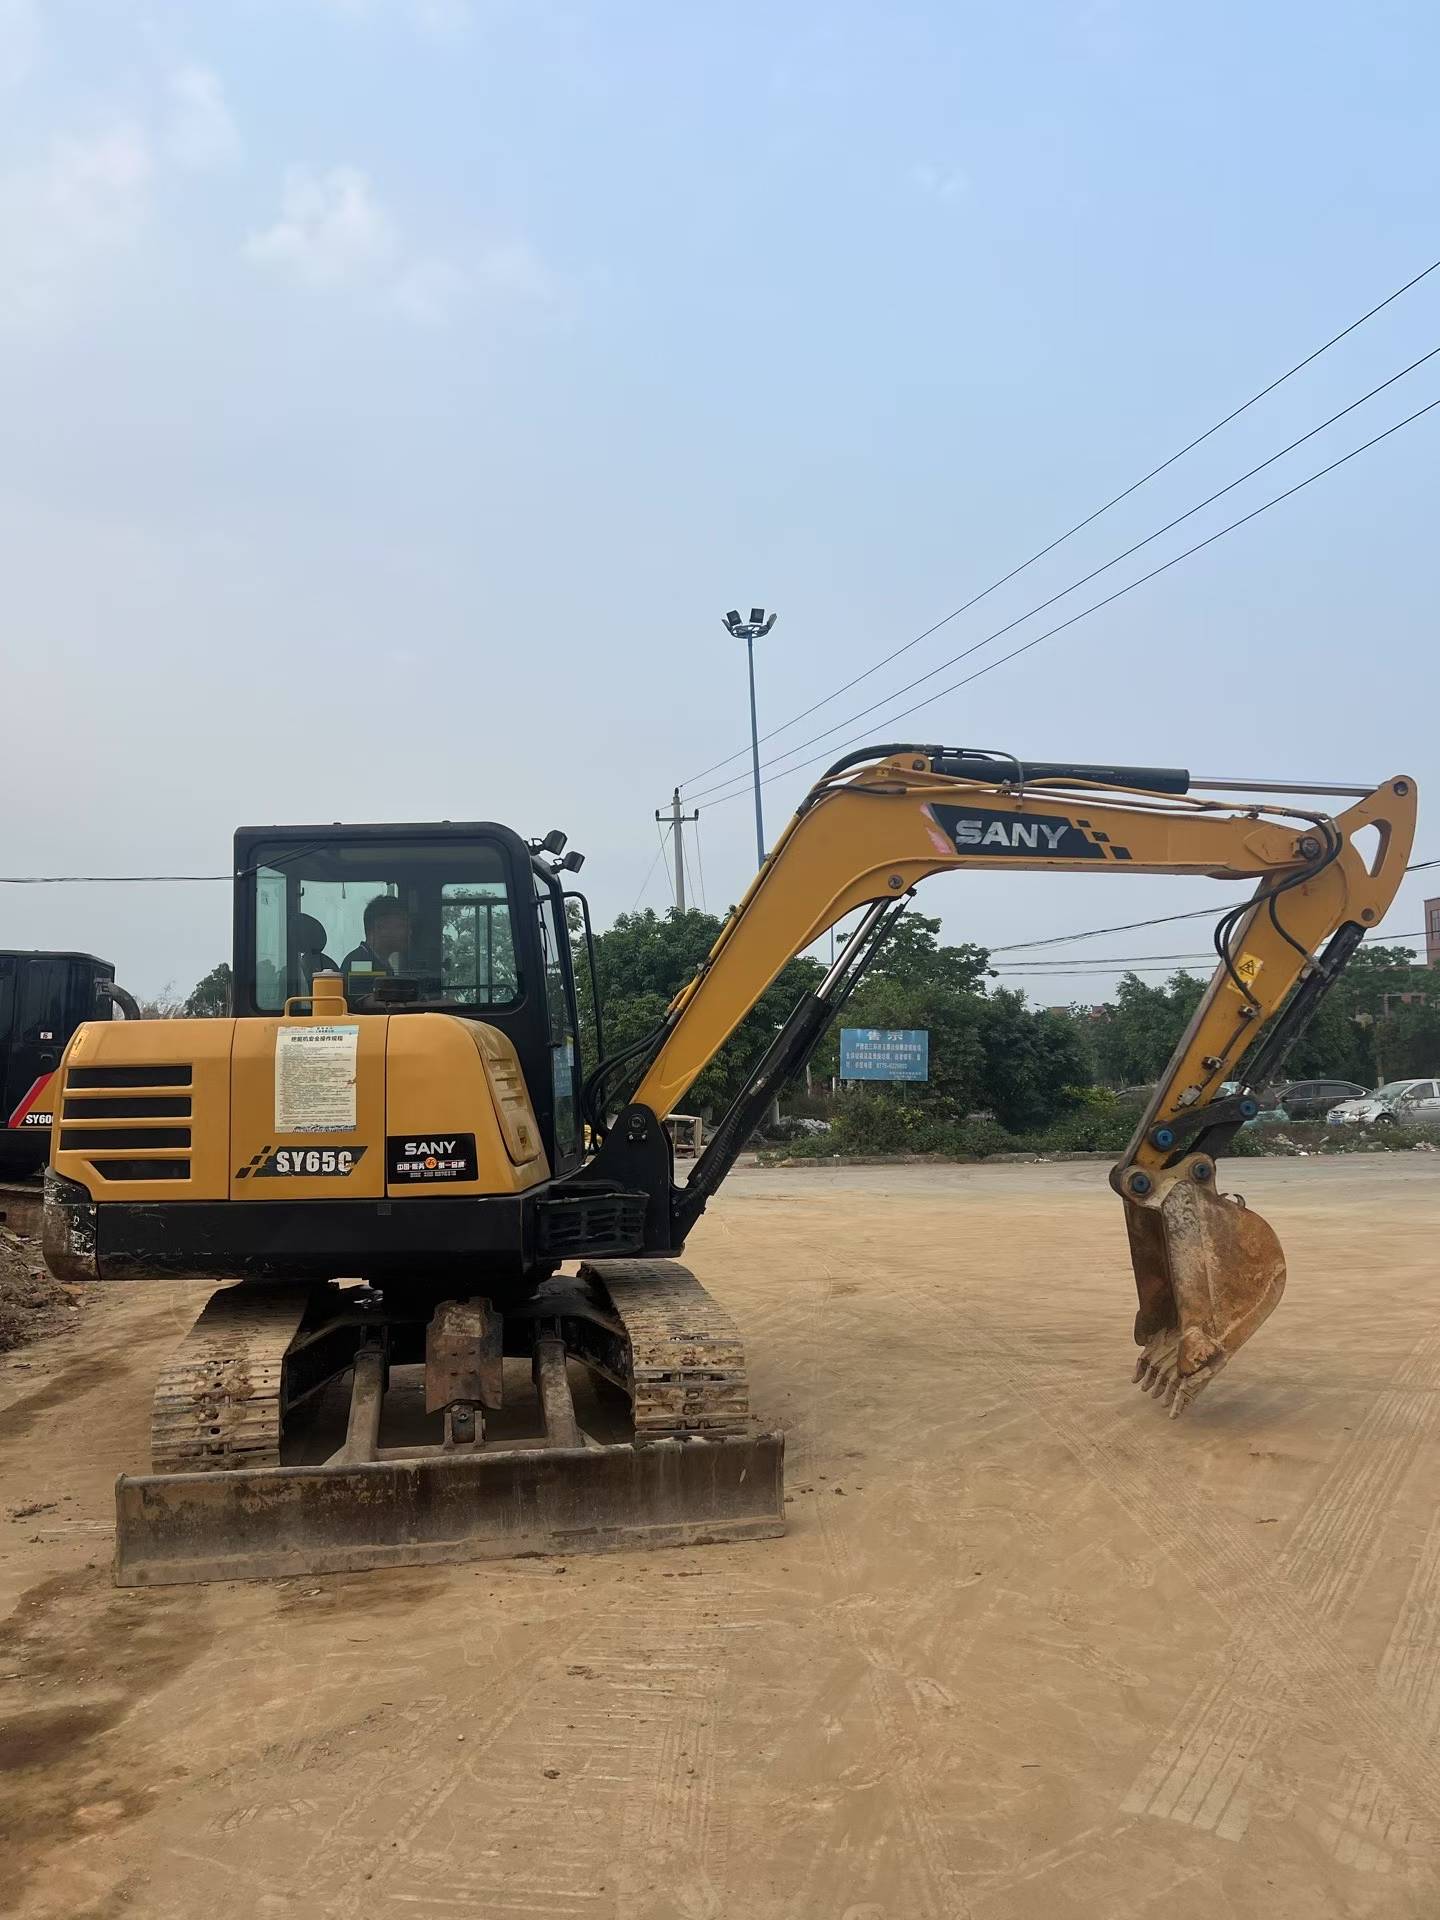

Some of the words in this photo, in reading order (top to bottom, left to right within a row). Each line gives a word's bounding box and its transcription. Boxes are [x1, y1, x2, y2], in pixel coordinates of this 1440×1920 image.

[955, 819, 1069, 849] SANY
[25, 1114, 53, 1124] SY60
[404, 1141, 456, 1155] SANY
[276, 1151, 352, 1172] SY65C
